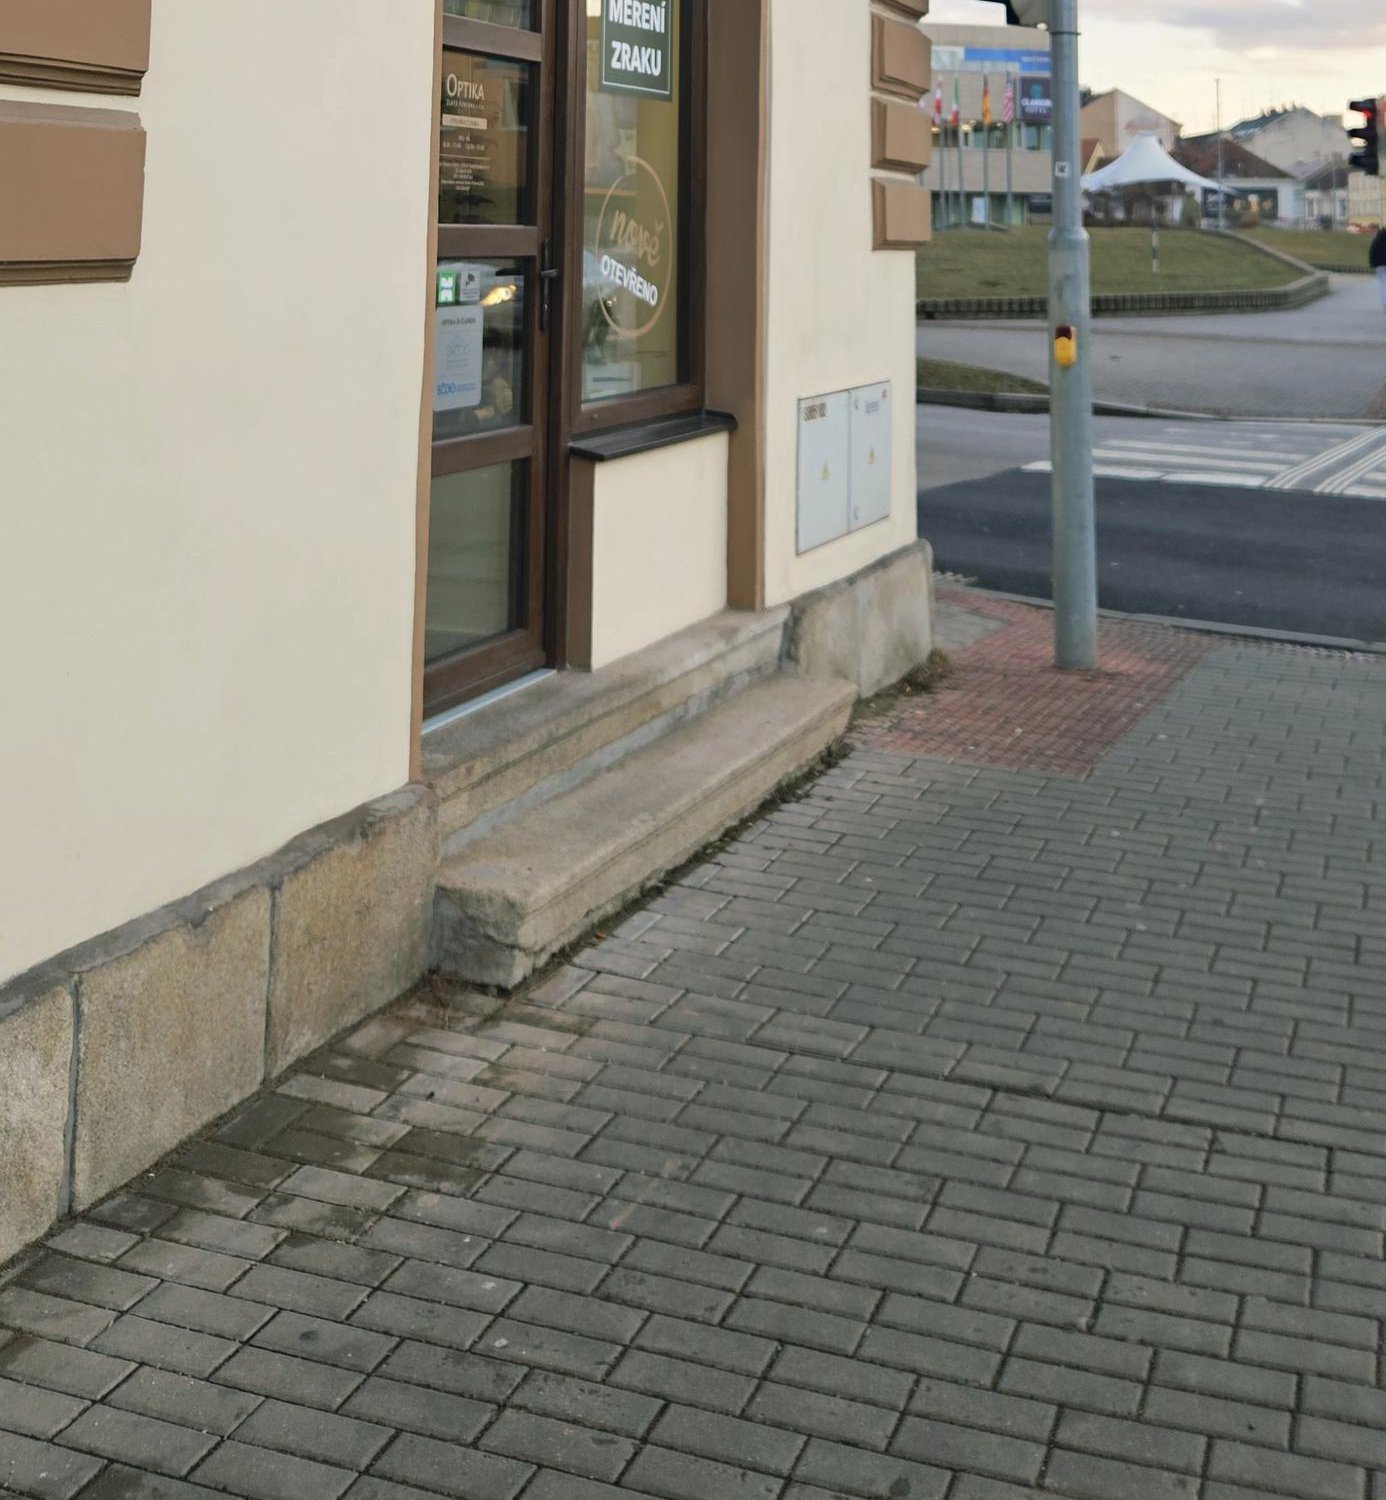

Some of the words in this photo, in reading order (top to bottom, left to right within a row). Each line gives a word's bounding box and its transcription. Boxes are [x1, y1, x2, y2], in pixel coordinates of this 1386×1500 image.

[610, 41, 662, 77] ZRAKU
[446, 73, 485, 101] OPTIKA
[601, 254, 659, 306] OTEVŘENO
